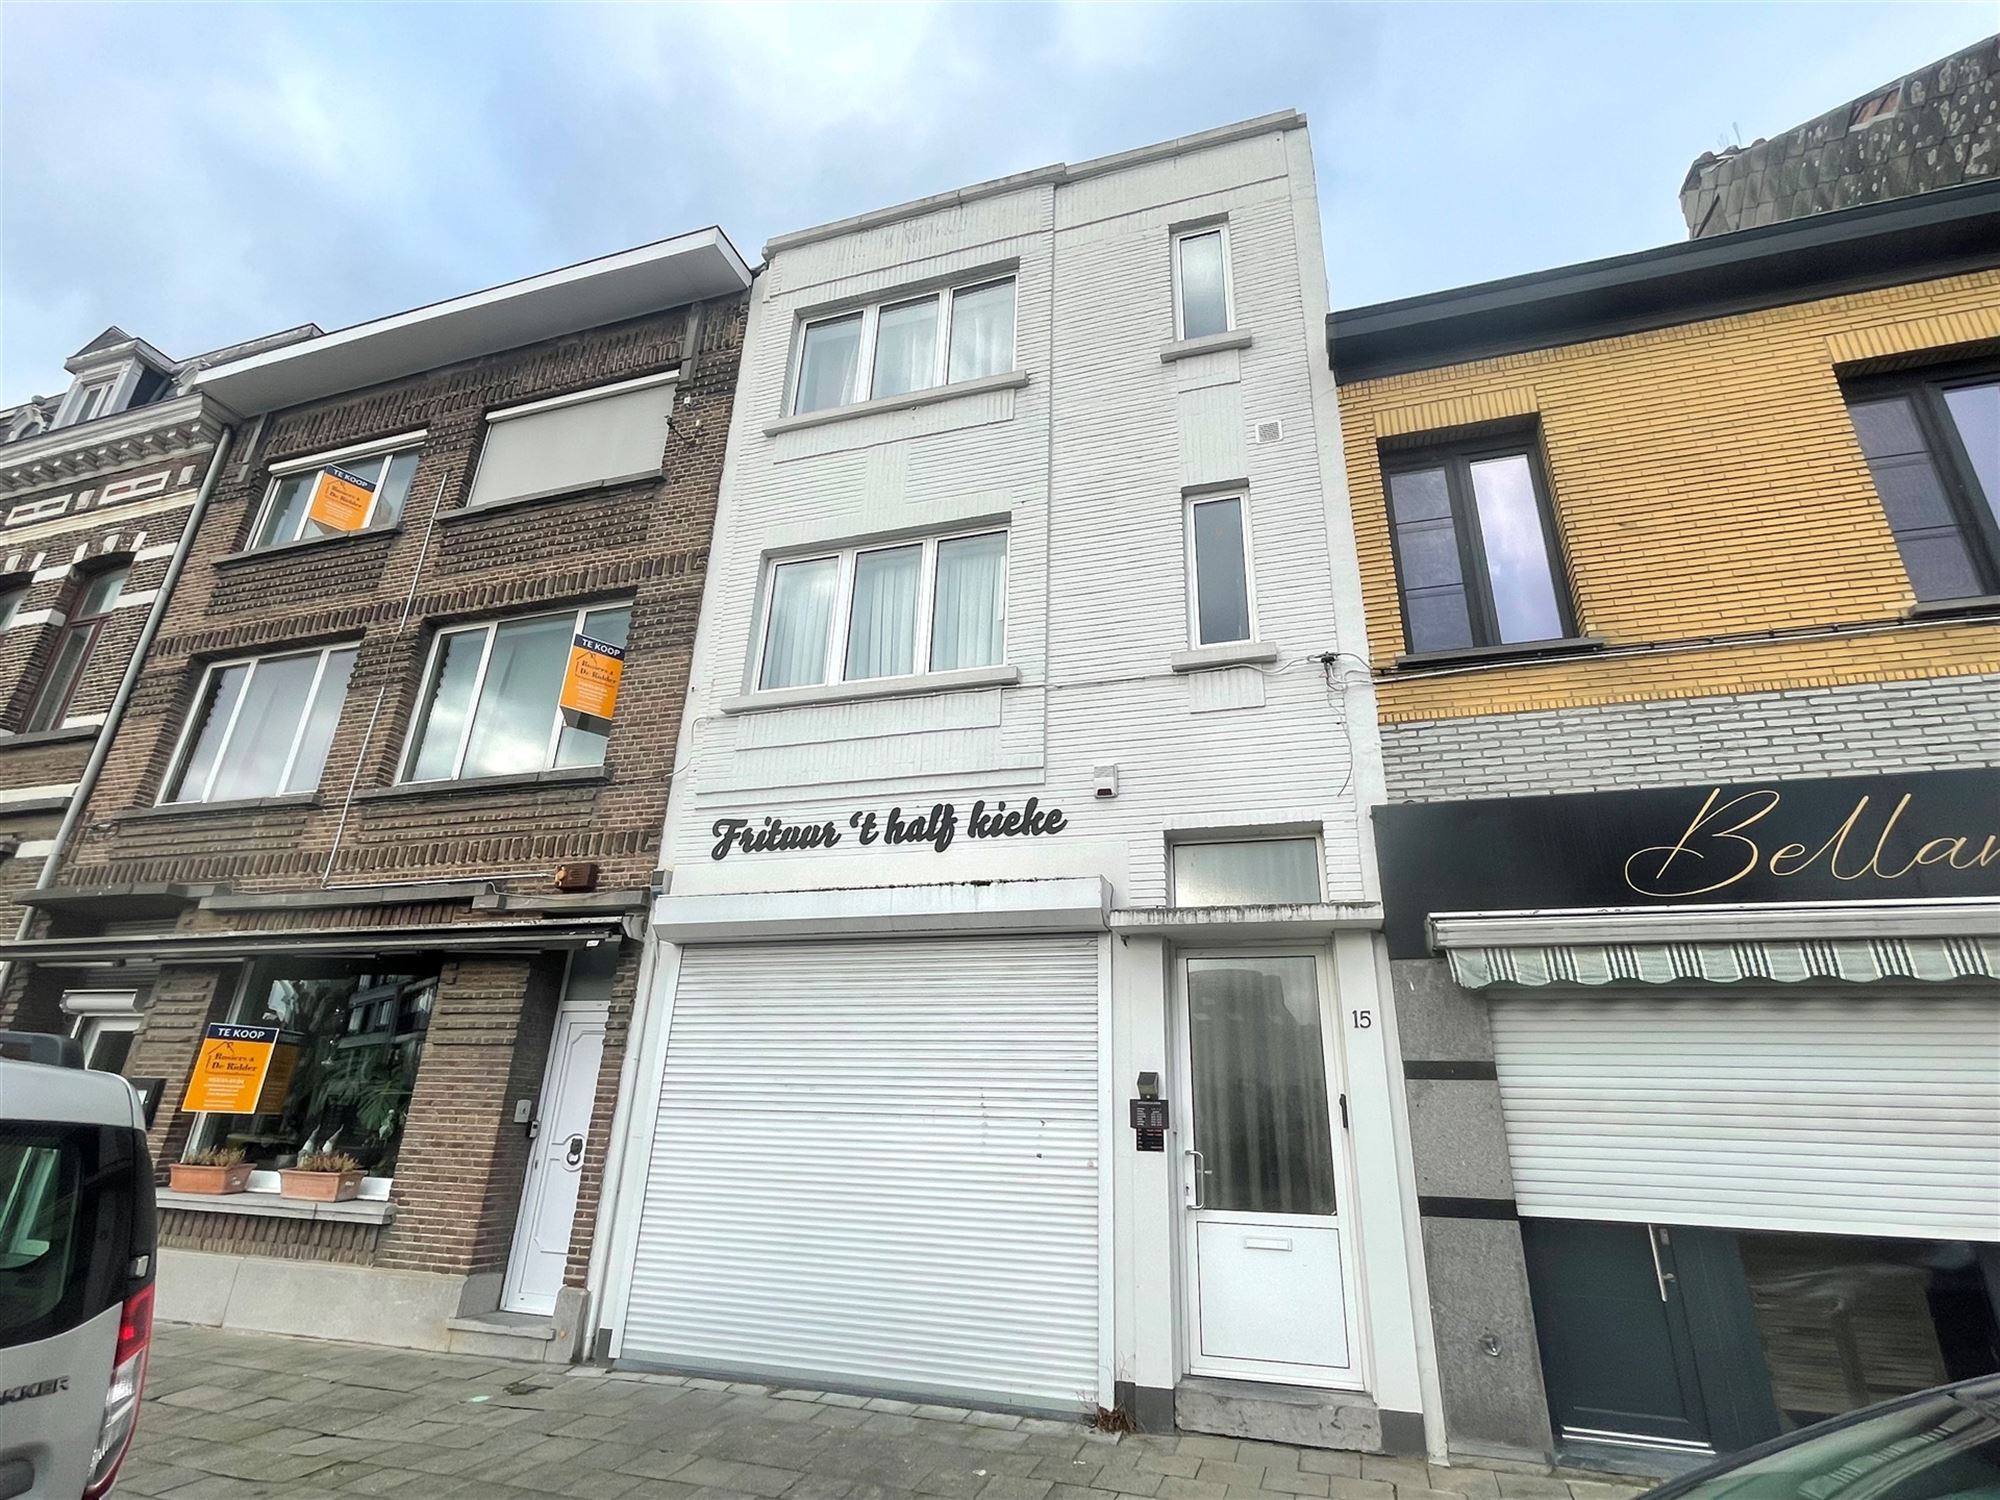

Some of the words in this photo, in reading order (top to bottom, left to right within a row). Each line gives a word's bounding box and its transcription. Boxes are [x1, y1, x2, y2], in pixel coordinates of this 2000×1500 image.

[333, 469, 343, 478] TE
[344, 473, 368, 488] KOOP
[582, 638, 594, 650] TE
[594, 643, 621, 656] KOOP
[710, 816, 842, 861] Frituur
[849, 810, 881, 846] 't
[883, 802, 959, 853] half
[966, 796, 1069, 839] kieke
[1352, 1010, 1372, 1029] 15
[218, 1027, 231, 1037] TE
[232, 1029, 265, 1039] KOOP
